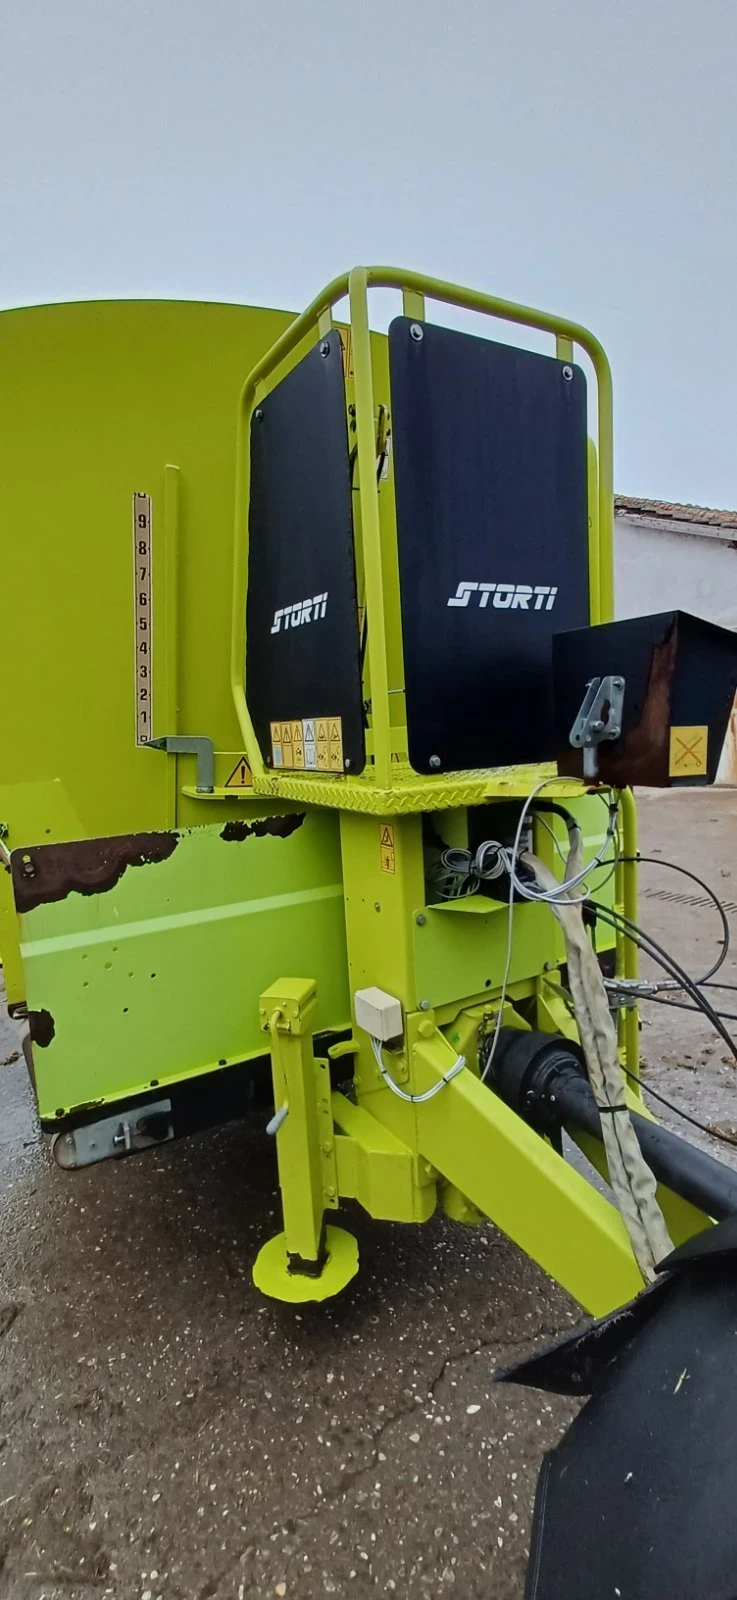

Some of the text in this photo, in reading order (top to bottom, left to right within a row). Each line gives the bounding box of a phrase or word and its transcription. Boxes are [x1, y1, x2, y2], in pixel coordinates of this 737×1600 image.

[138, 514, 147, 529] 9
[138, 541, 147, 556] 8
[139, 567, 147, 581] 7
[139, 592, 147, 606] 6
[447, 581, 558, 611] STORTI
[270, 592, 329, 635] STORTI
[139, 617, 148, 631] 5
[139, 641, 148, 655] 4
[139, 665, 148, 678] 3
[139, 688, 148, 701] 2
[140, 710, 147, 723] 1
